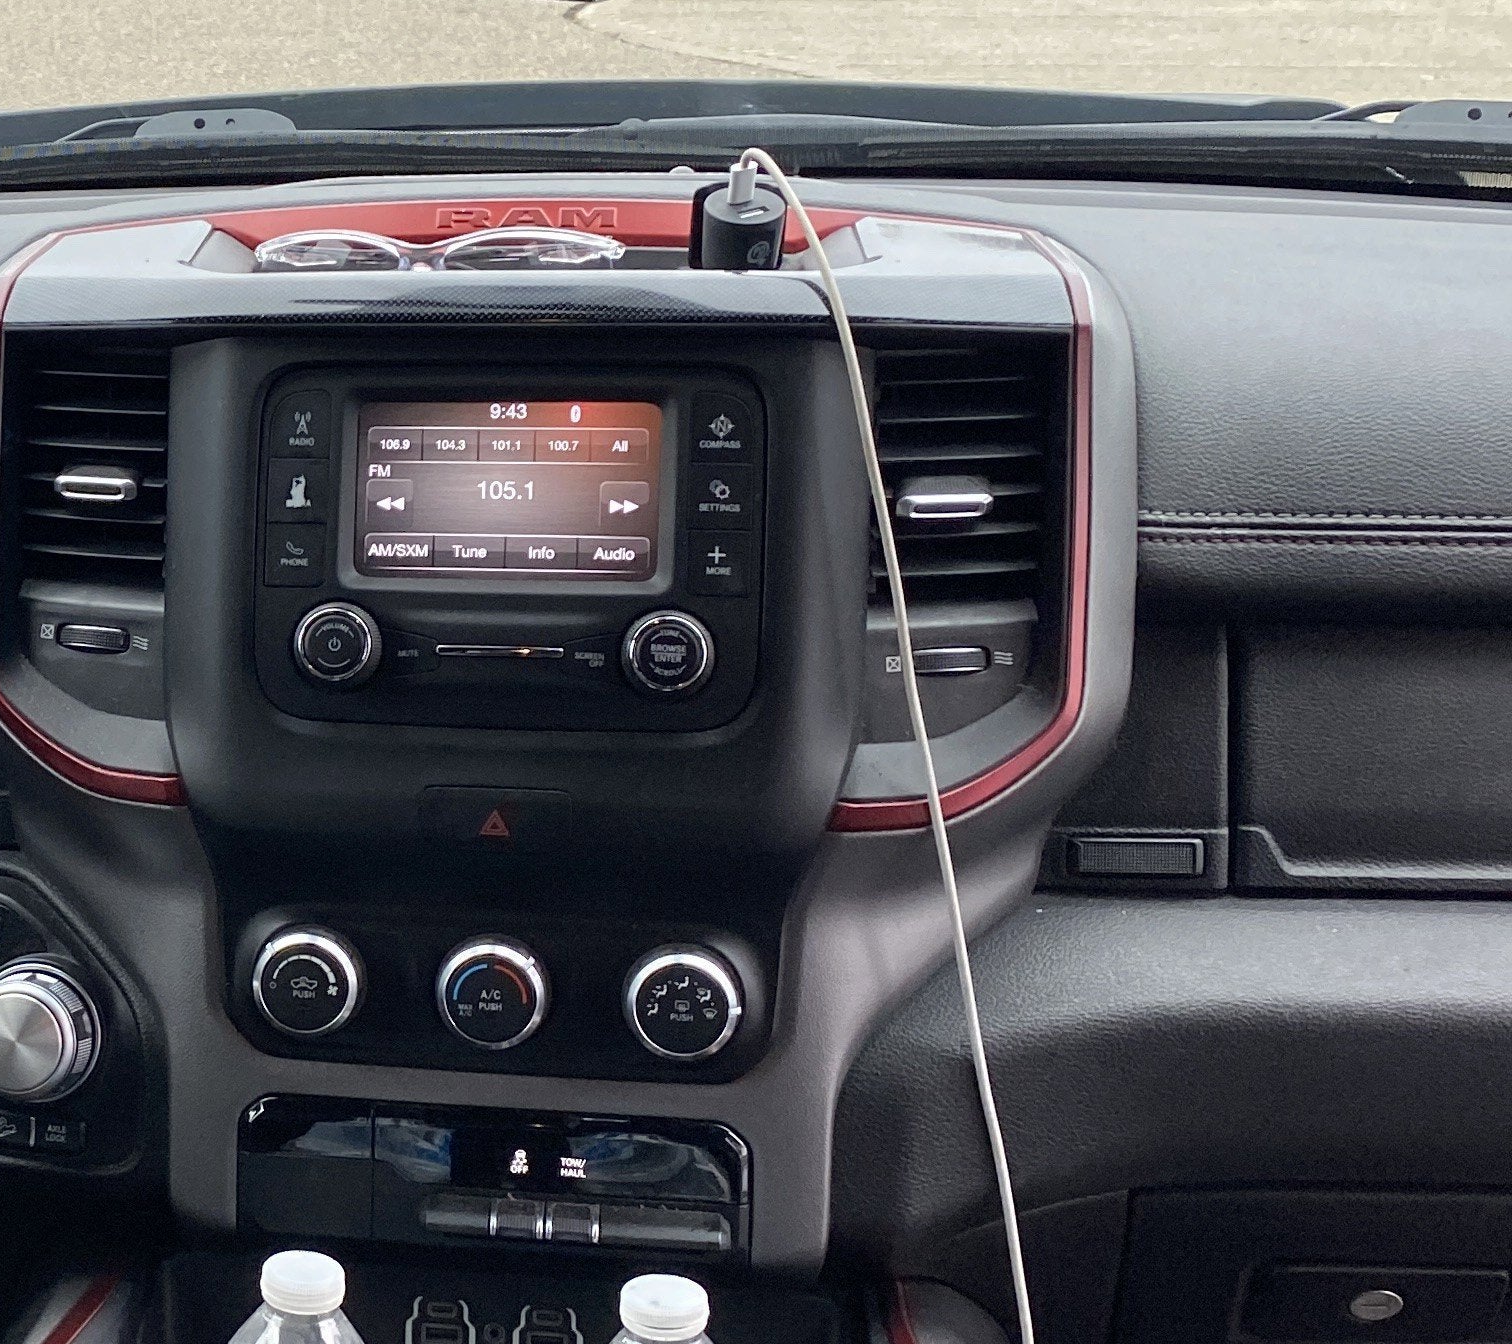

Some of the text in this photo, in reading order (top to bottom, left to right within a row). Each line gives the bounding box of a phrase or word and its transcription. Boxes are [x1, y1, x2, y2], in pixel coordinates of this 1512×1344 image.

[437, 207, 617, 229] RAM
[490, 403, 528, 419] 9:43
[289, 437, 315, 447] RADIO
[380, 439, 629, 453] 106.9 104.3 101.1 100.7 All
[699, 440, 741, 449] COMPASS
[368, 465, 391, 477] FM
[477, 480, 535, 500] 105.1
[699, 503, 740, 512] SETTINGS
[368, 544, 635, 561] AM/SXM Tune Info Audio
[280, 558, 309, 567] PHONE
[706, 567, 731, 576] MORE
[650, 644, 687, 652] BROWSE
[654, 655, 682, 663] ENTER
[292, 989, 316, 998] PUSH
[480, 989, 501, 1000] A/C
[478, 1002, 503, 1011] PUSH
[670, 1013, 694, 1022] PUSH
[560, 1157, 587, 1168] TOW/
[510, 1165, 529, 1174] OFF
[560, 1167, 587, 1179] HAUL
